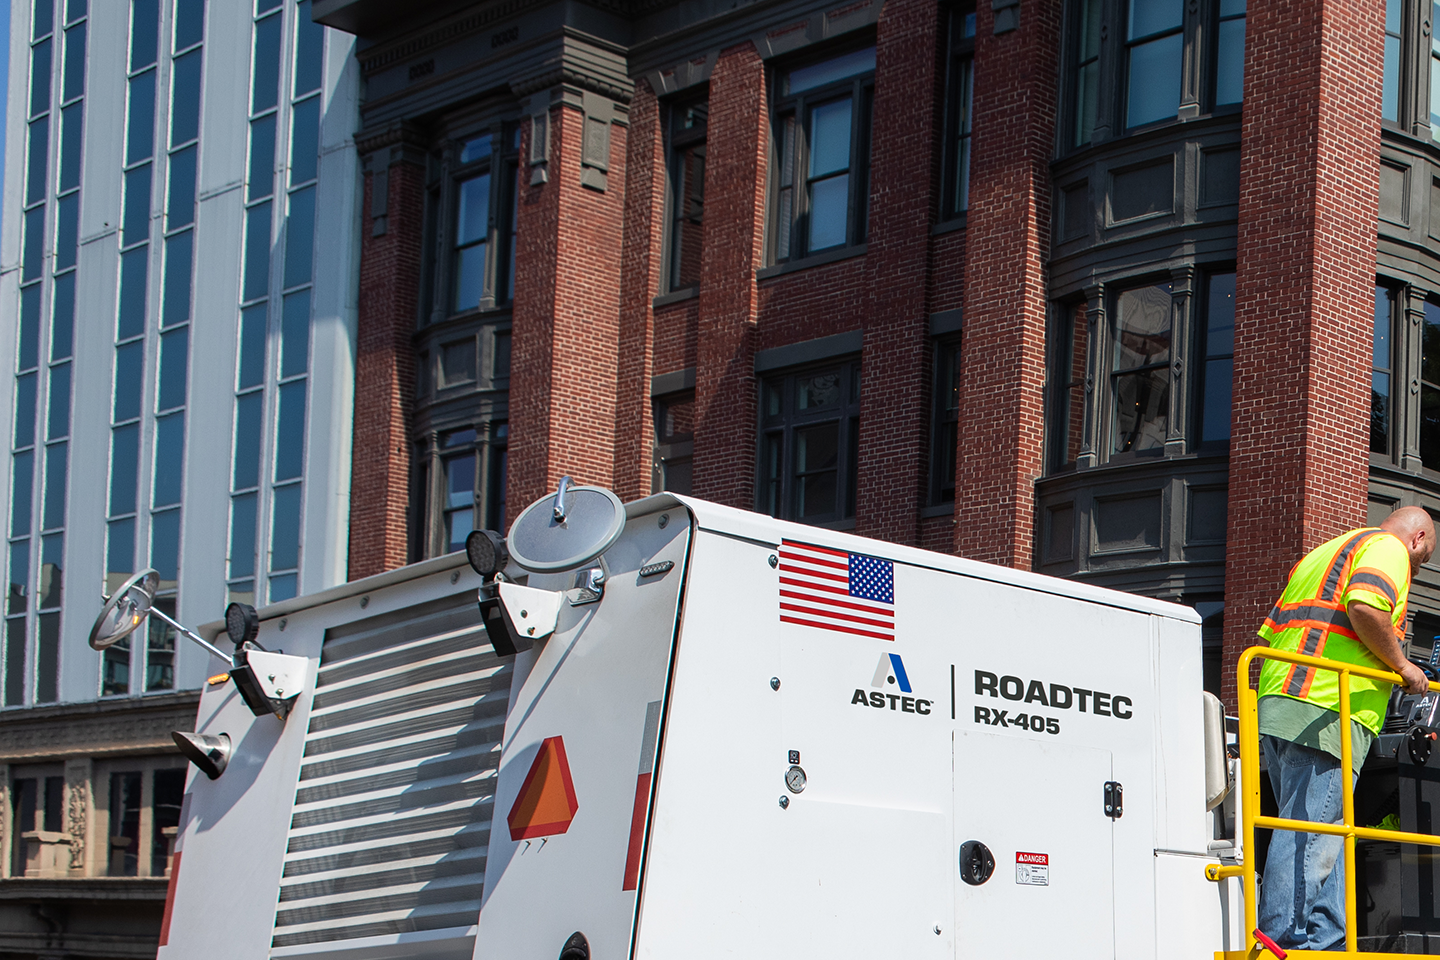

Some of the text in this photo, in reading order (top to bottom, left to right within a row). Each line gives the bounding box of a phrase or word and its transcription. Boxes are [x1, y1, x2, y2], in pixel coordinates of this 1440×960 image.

[974, 670, 1133, 720] ROADTEC
[974, 706, 1060, 735] RX-405
[1024, 855, 1046, 863] DANGER
